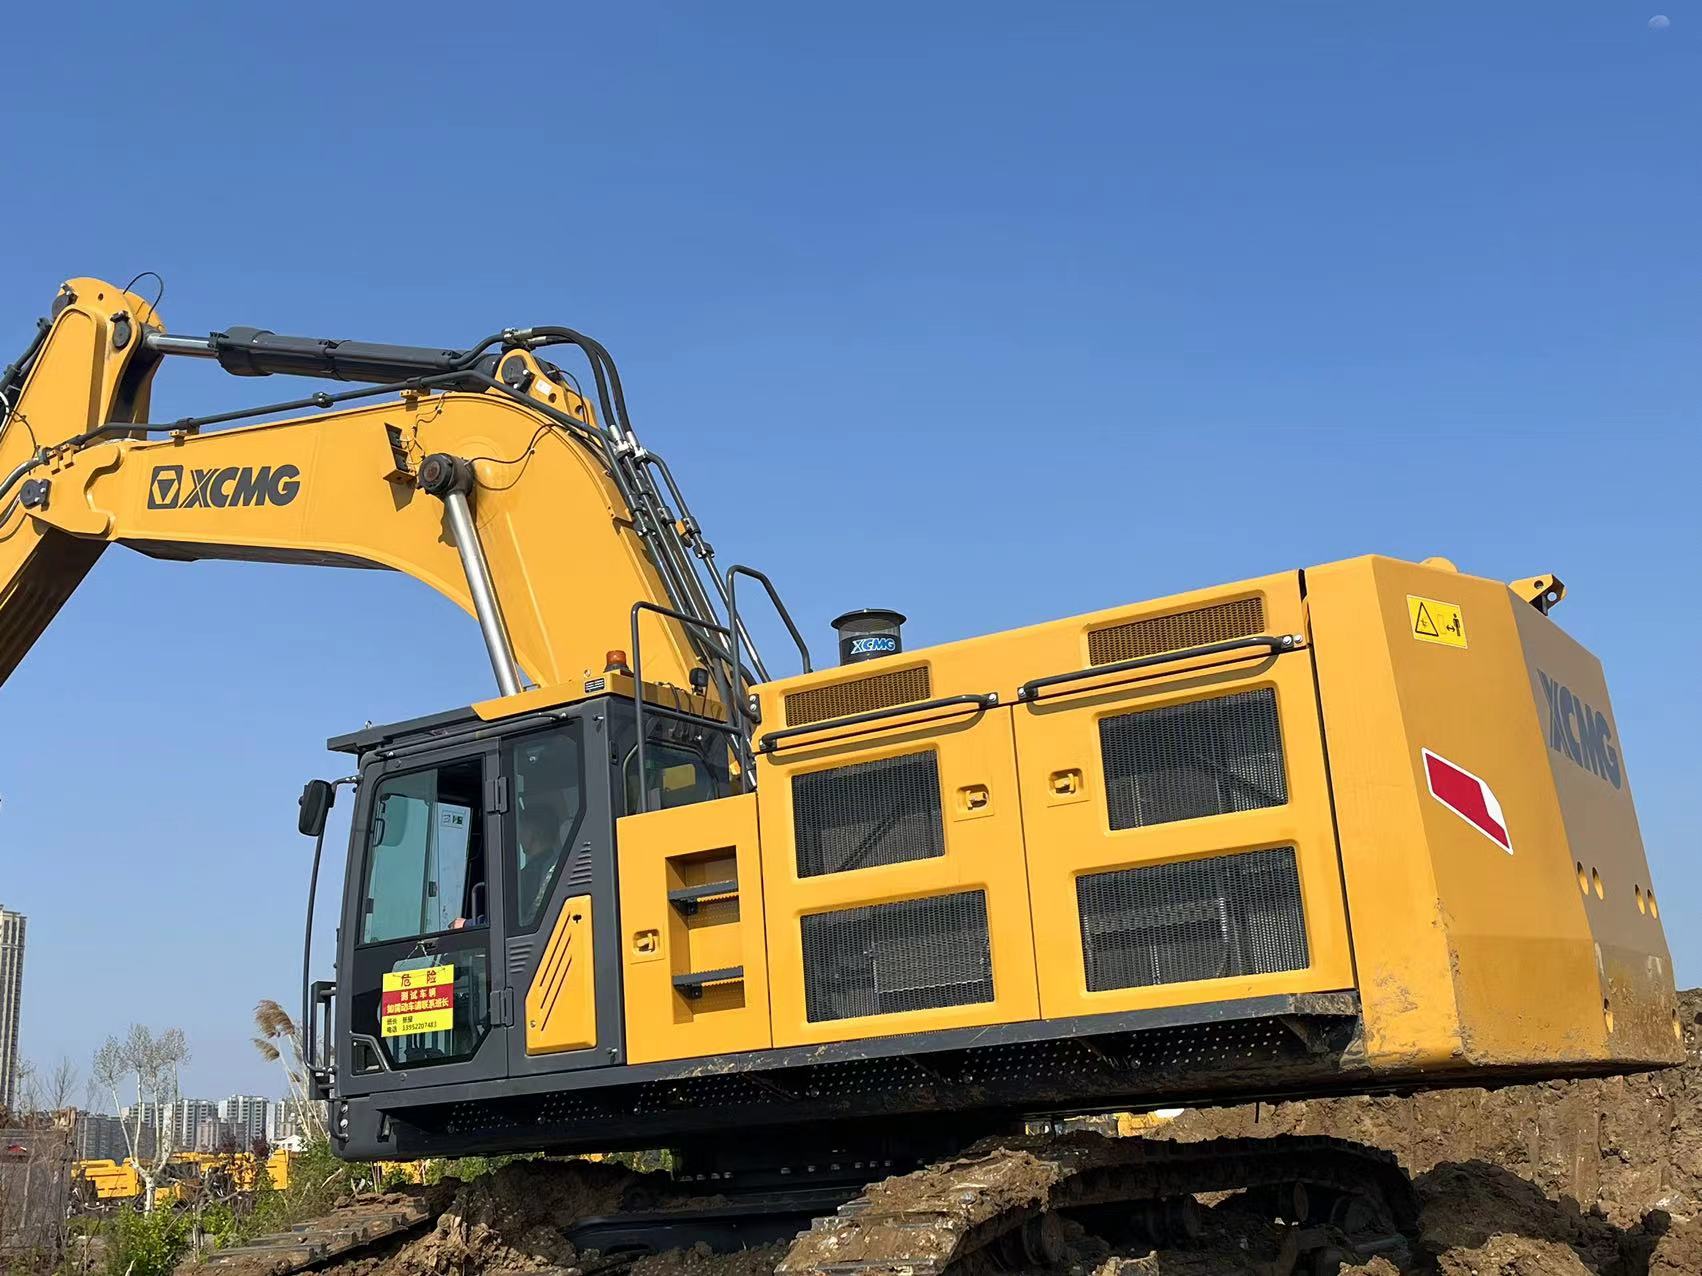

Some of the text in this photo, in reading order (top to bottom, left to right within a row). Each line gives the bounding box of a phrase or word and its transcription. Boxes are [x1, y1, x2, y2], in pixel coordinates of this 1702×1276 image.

[178, 464, 301, 508] XCMG
[850, 638, 896, 655] XCMG
[1536, 667, 1621, 790] XCMG
